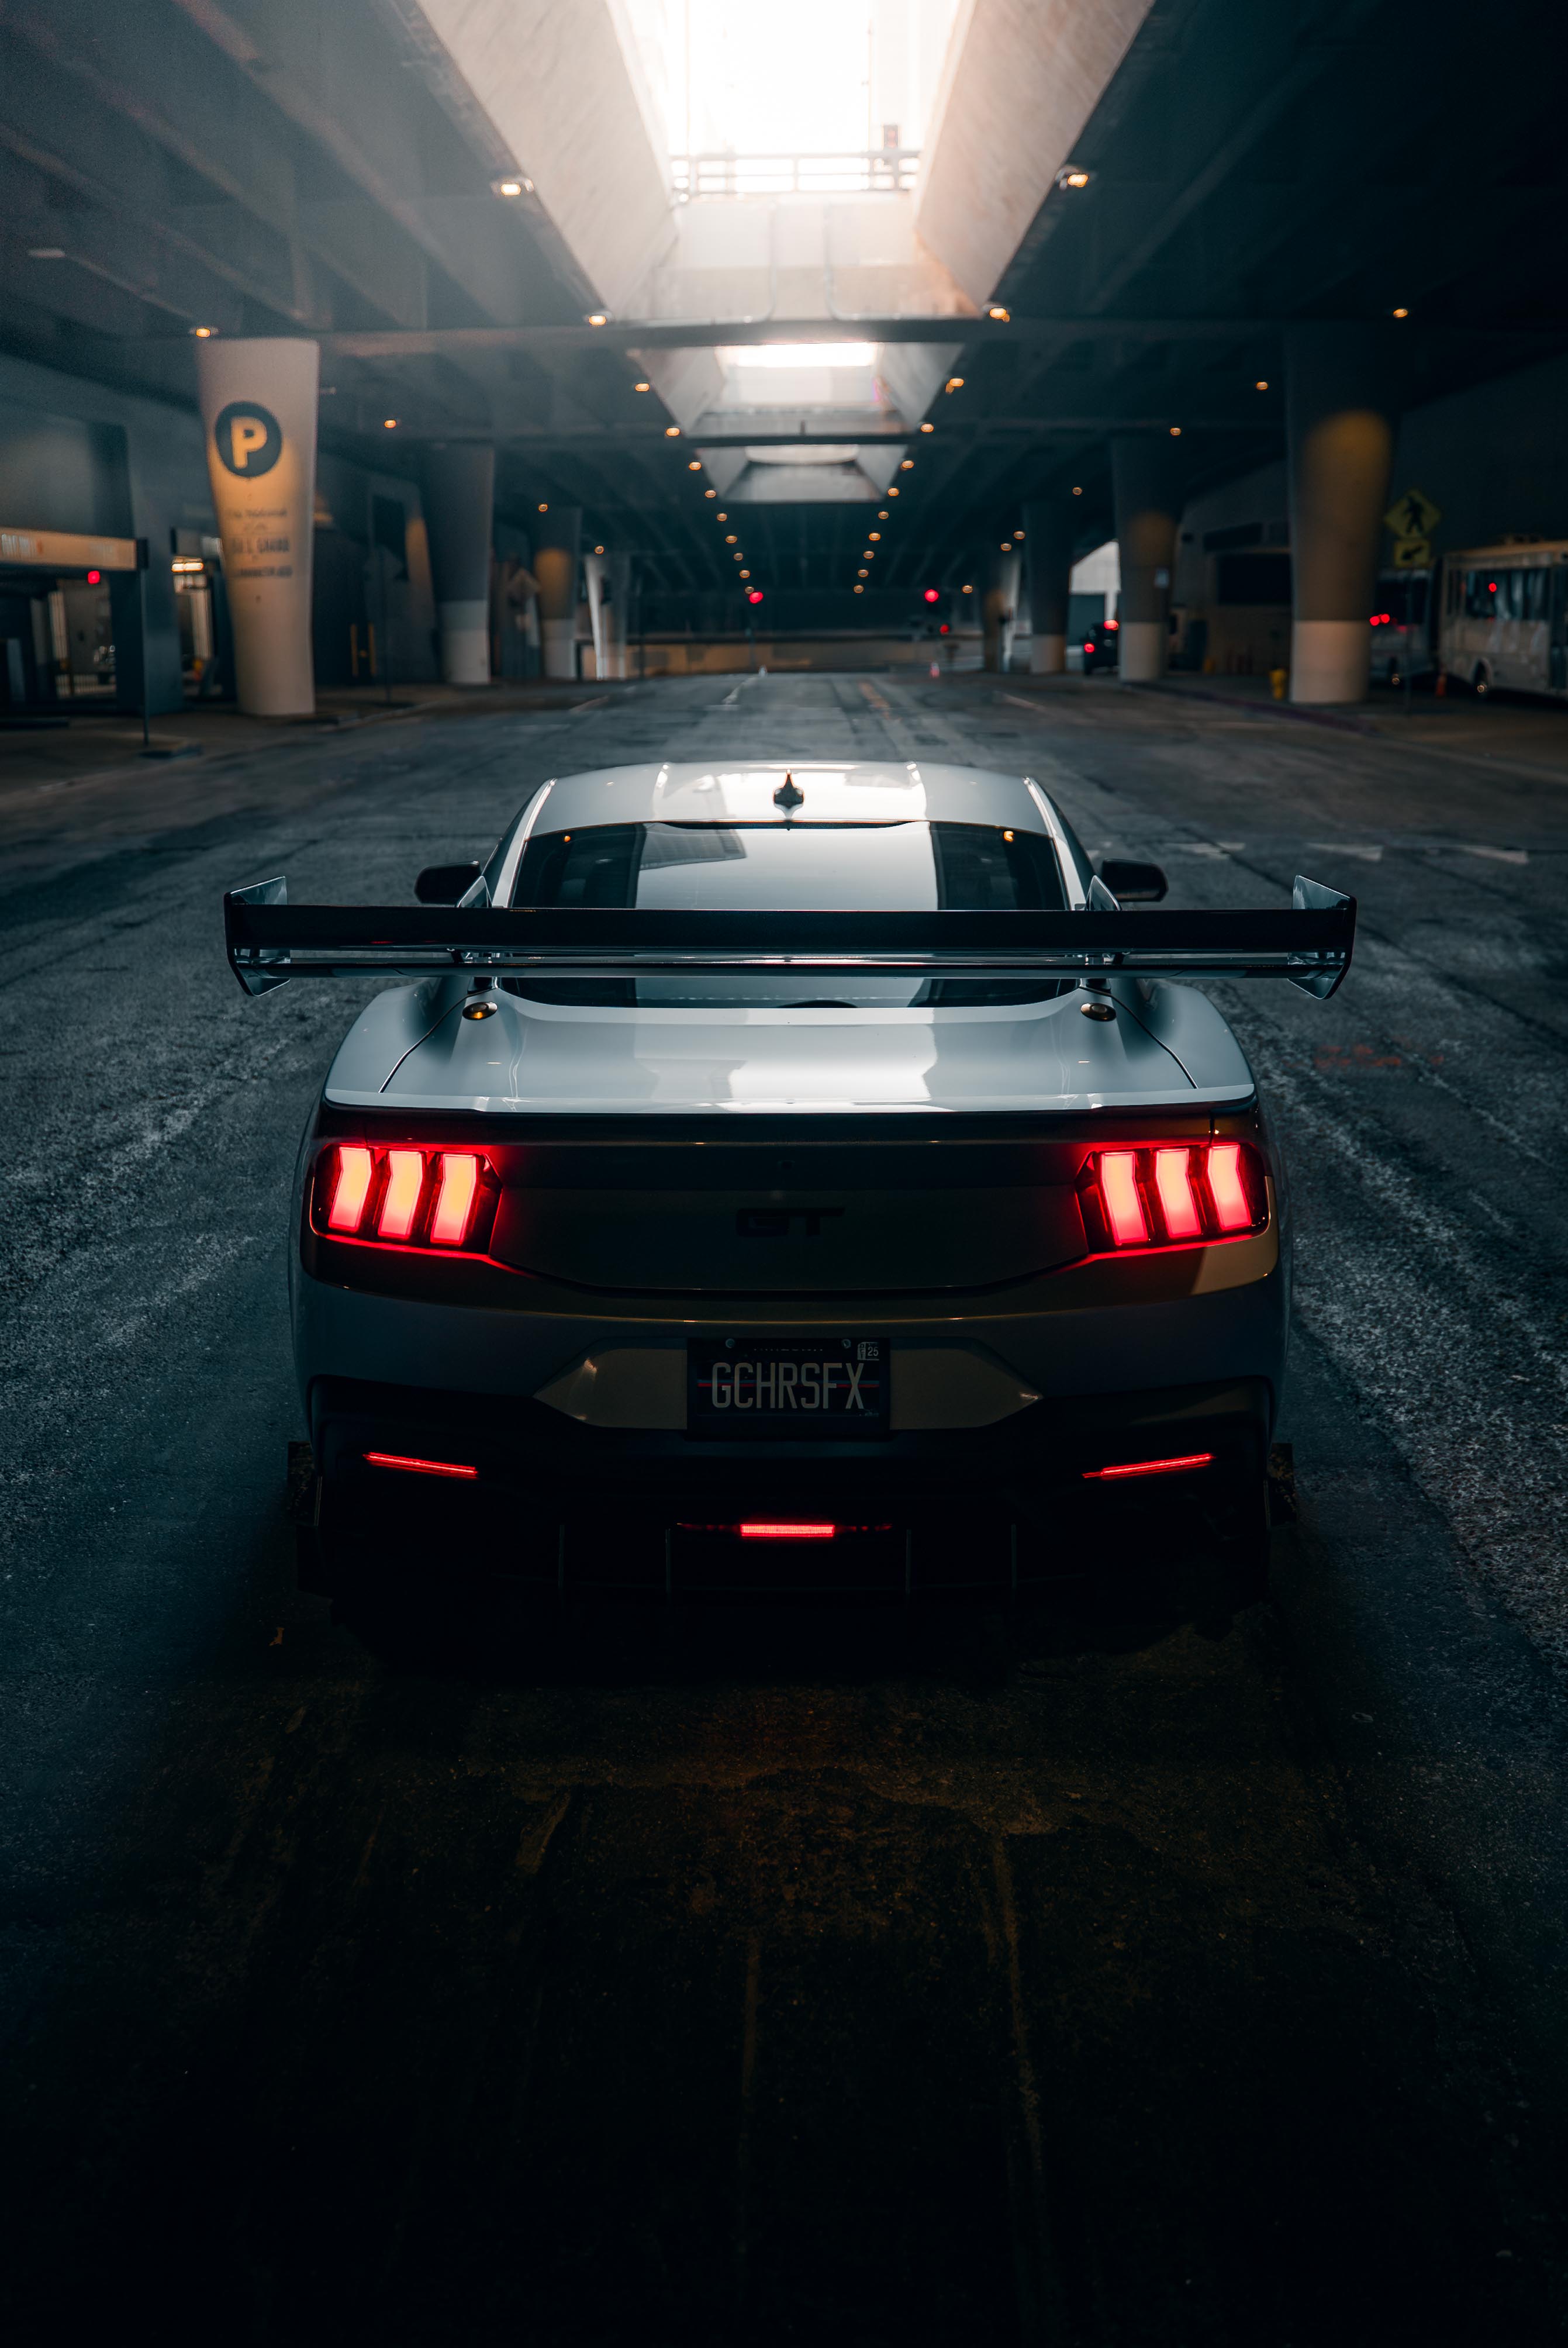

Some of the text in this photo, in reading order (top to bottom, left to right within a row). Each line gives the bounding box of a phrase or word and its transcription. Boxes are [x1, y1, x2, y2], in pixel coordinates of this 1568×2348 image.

[230, 416, 268, 469] P
[736, 1208, 845, 1237] GT
[868, 1346, 879, 1356] 25
[712, 1362, 865, 1410] GCHRSFX
